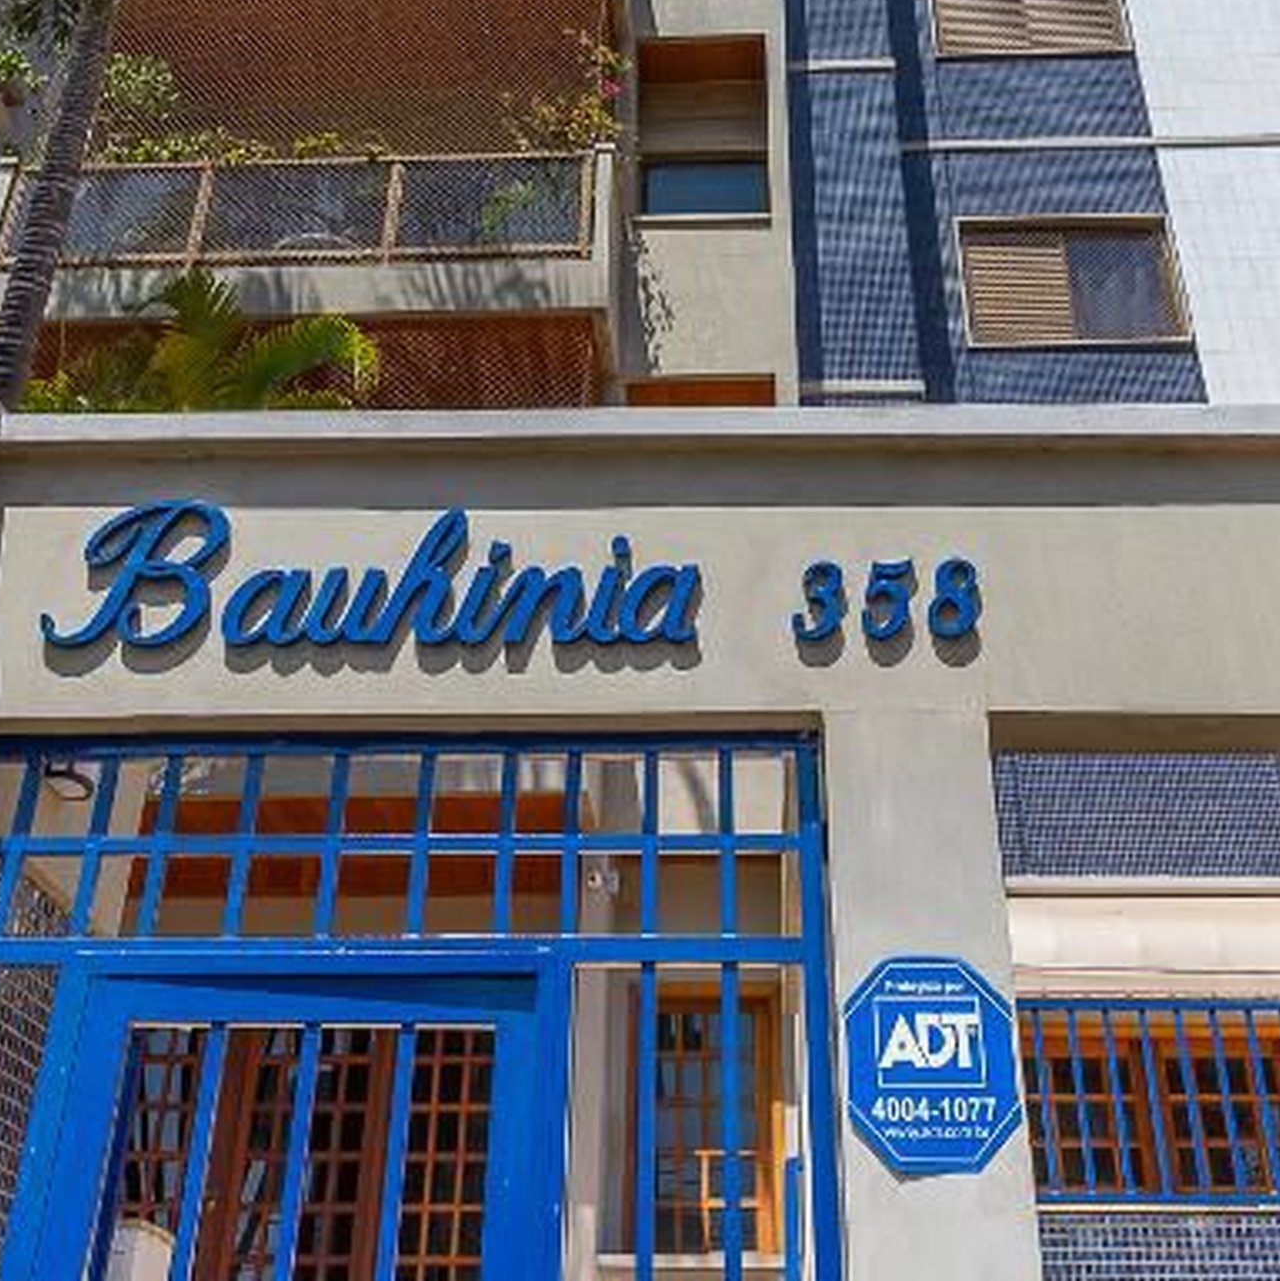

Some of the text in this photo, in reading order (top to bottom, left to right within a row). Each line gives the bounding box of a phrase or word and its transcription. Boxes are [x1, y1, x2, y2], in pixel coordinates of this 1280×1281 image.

[40, 499, 982, 647] Bauhinia 358
[878, 1012, 979, 1069] ADT
[871, 1097, 996, 1122] 4004-1077
